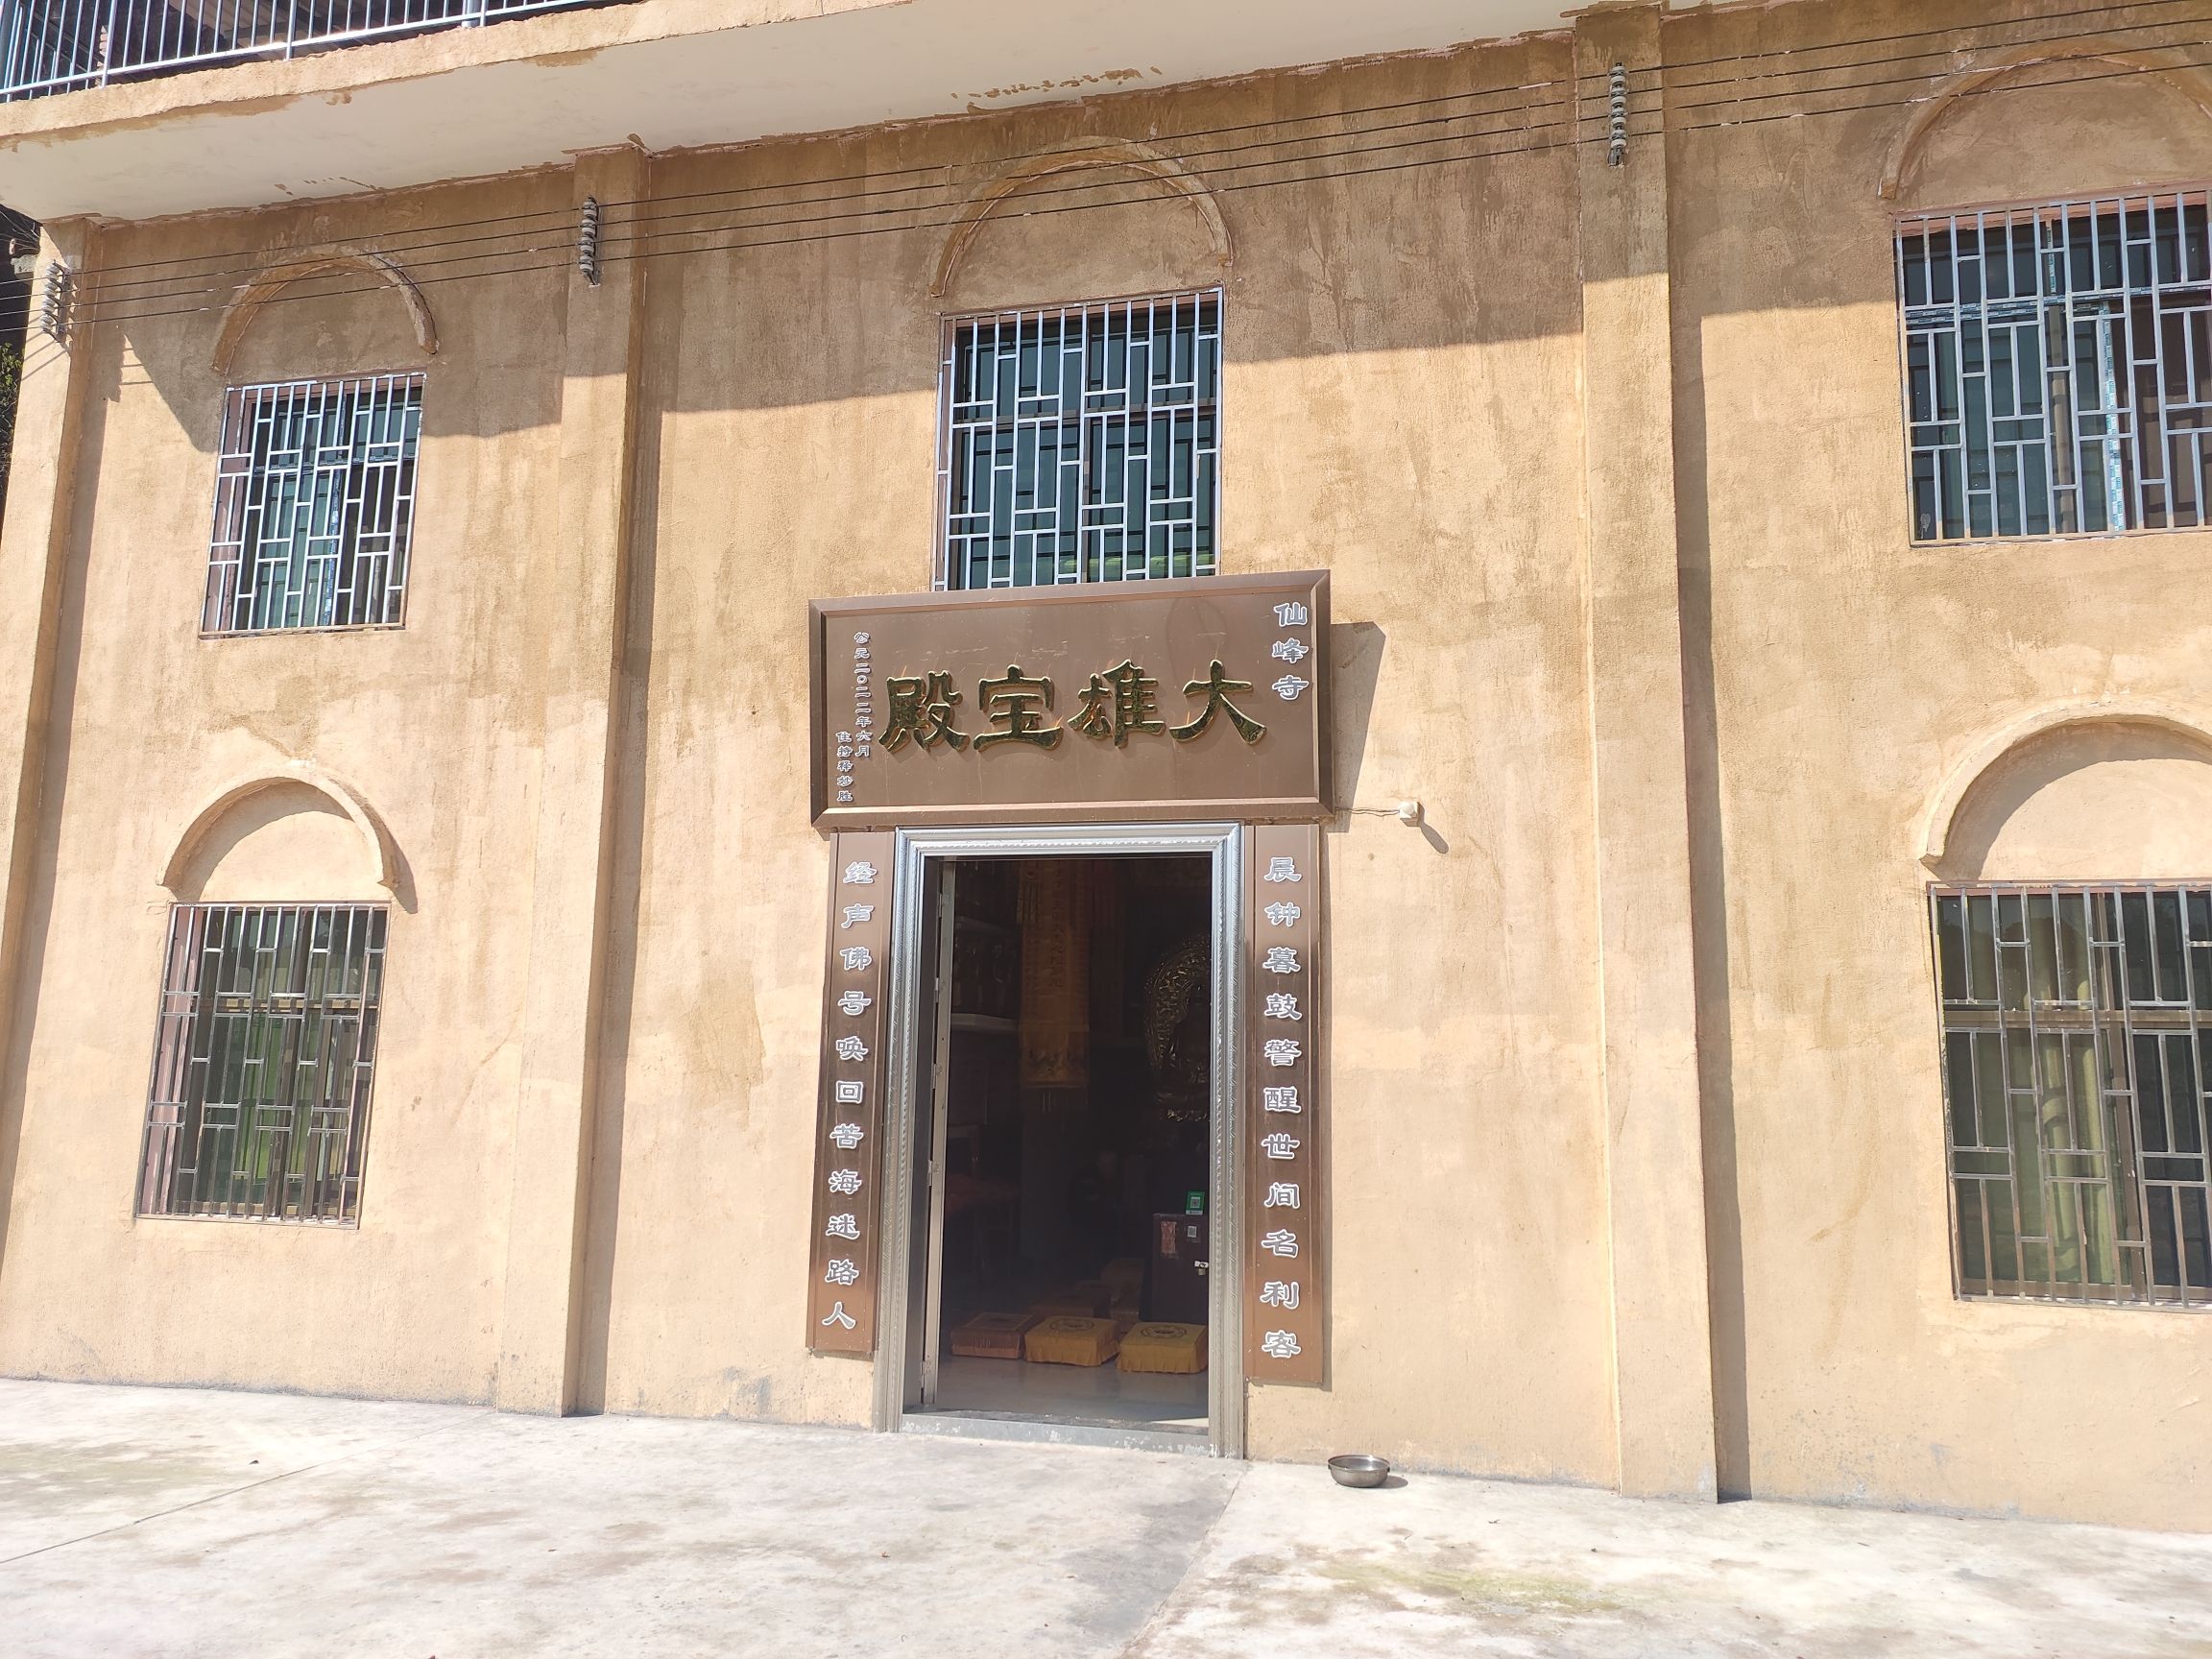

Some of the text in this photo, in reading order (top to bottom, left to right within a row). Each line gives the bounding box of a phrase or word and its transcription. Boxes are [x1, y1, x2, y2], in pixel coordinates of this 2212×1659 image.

[1272, 601, 1309, 700] 仙峰寺
[822, 861, 878, 1330] 经声佛号唤回苦海迷路人
[1260, 856, 1303, 1358] 晨钟暮鼓警醒世间名利客
